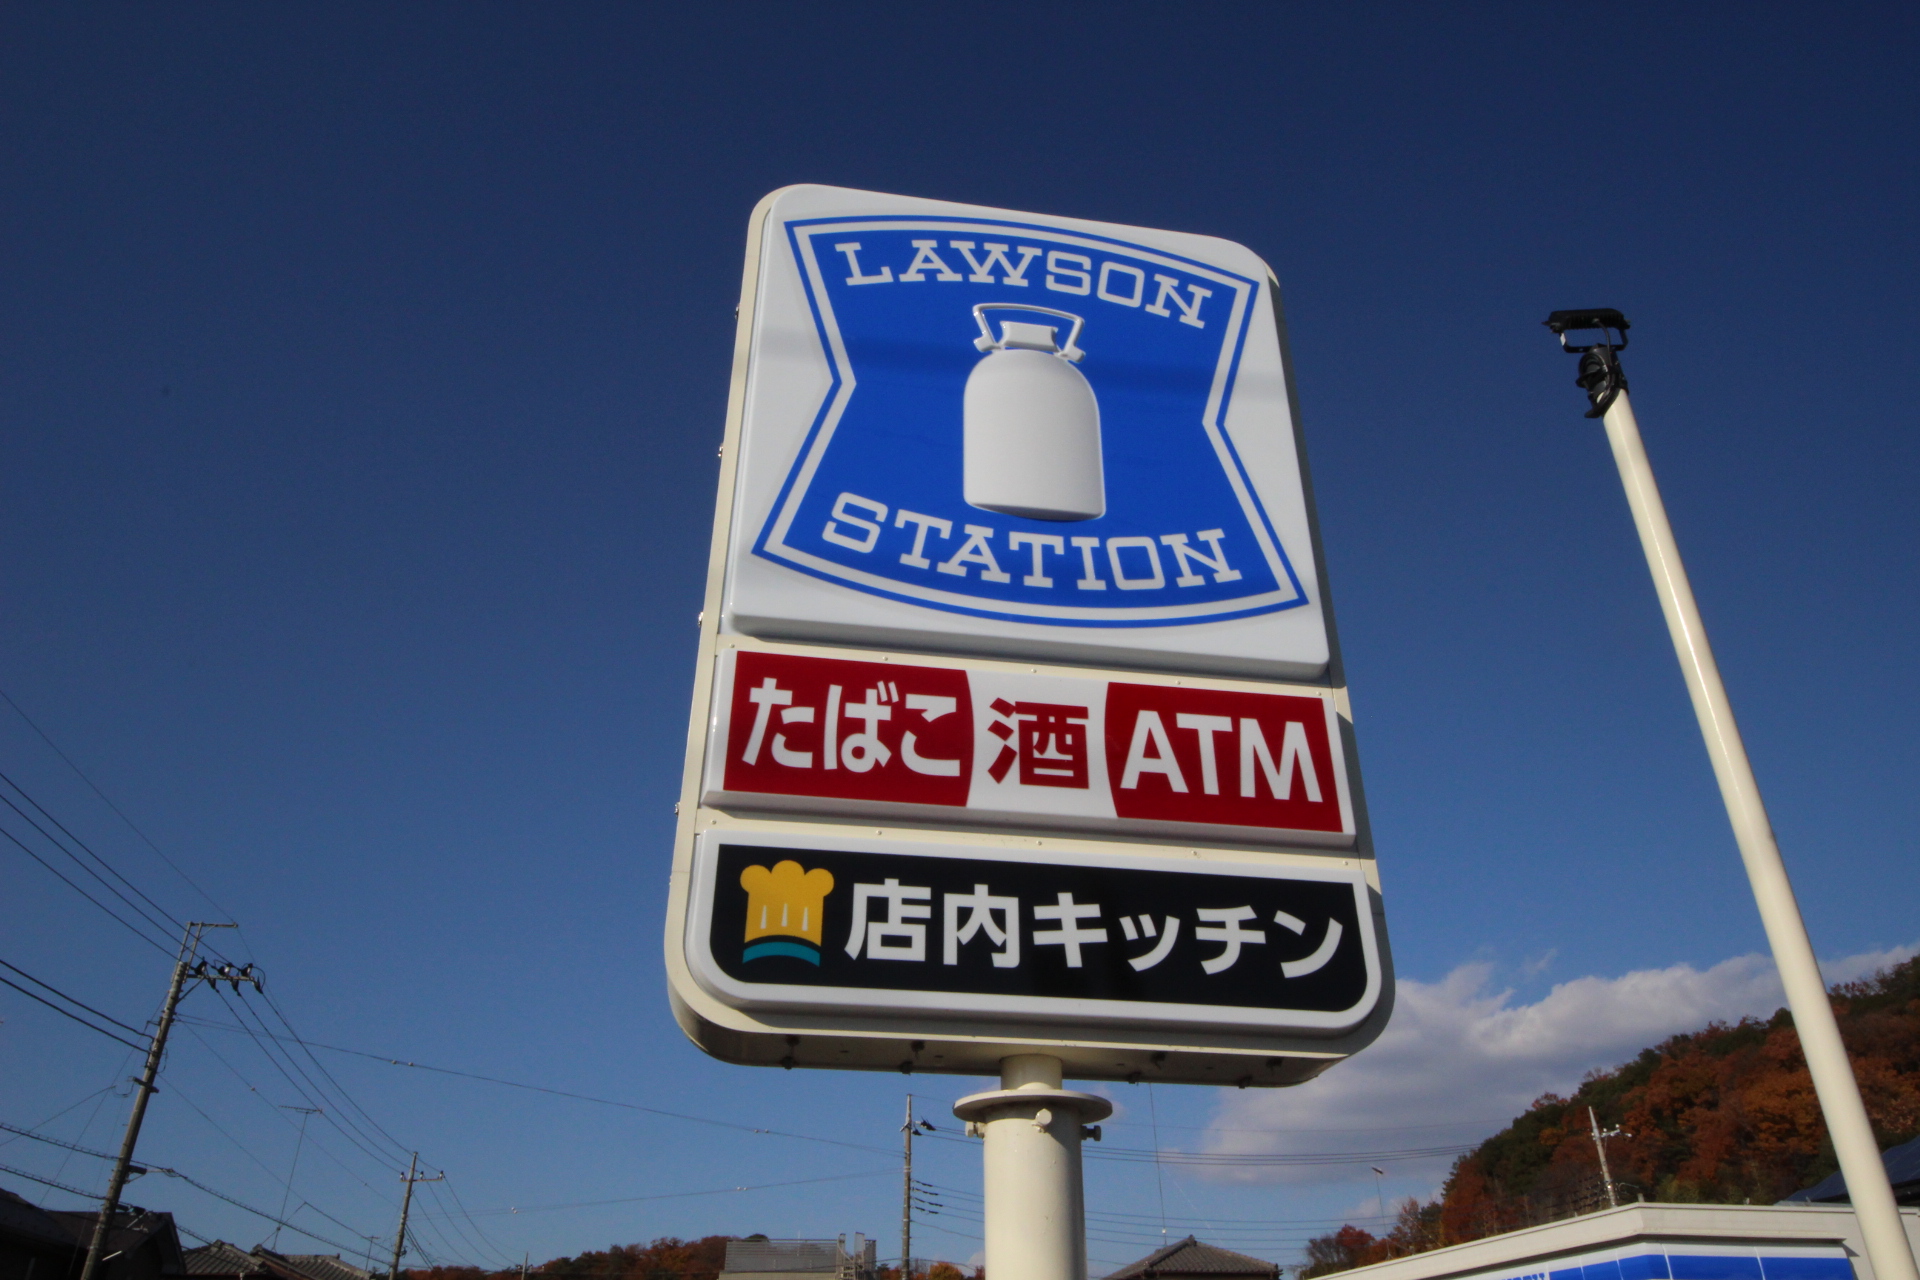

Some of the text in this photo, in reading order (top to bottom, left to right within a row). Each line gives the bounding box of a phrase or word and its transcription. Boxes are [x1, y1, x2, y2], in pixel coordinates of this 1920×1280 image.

[835, 239, 1213, 329] LAWSON
[822, 492, 1243, 591] STATION
[742, 677, 1323, 802] たばこ 酒 ATM
[844, 878, 1343, 979] 店内キッチン
